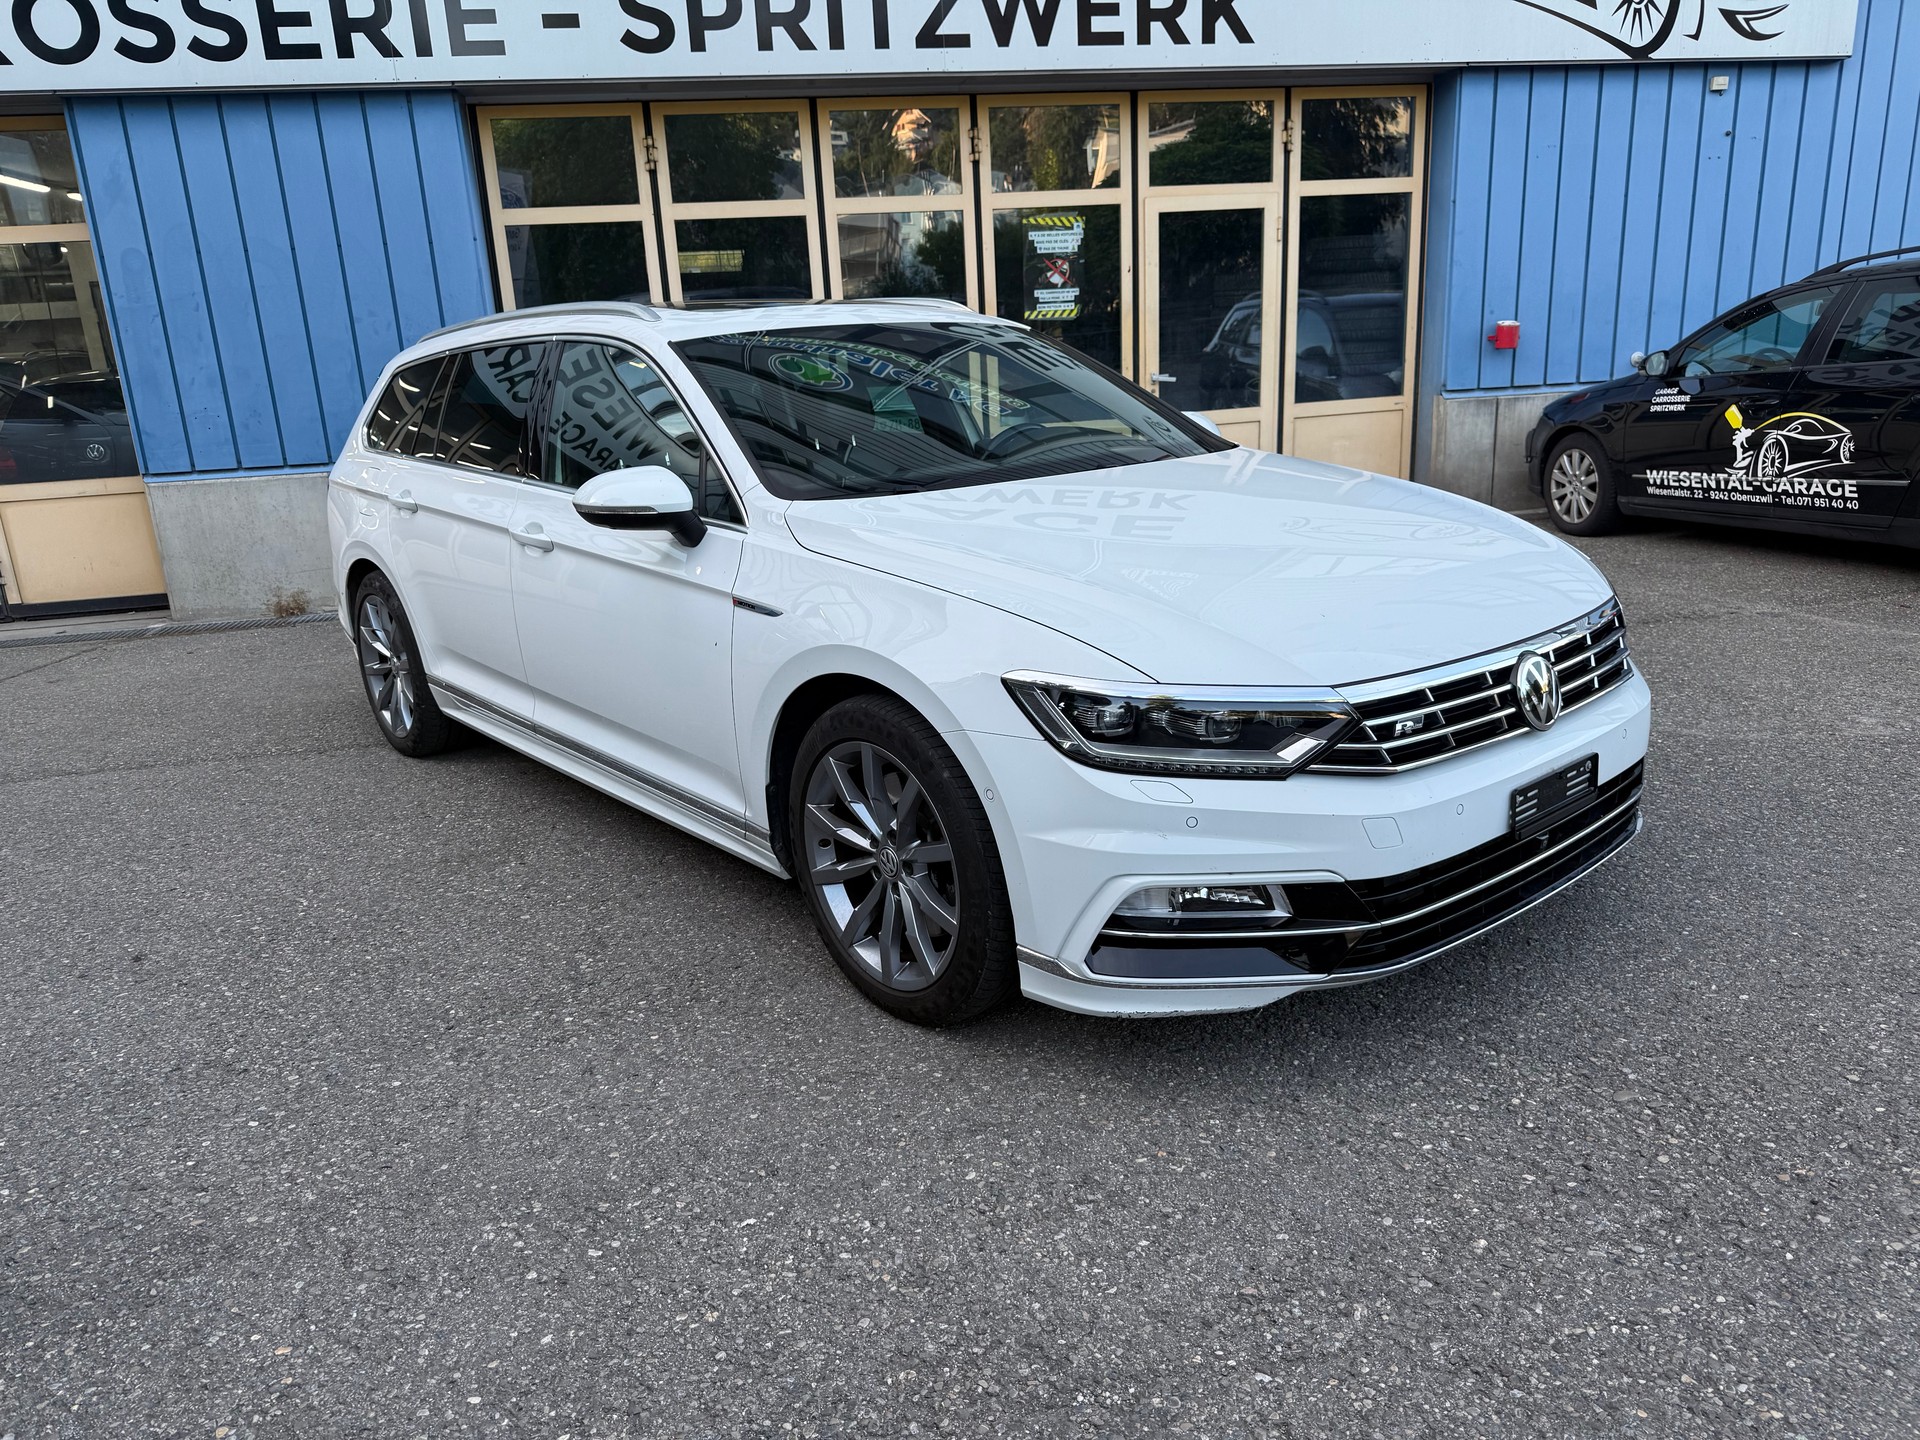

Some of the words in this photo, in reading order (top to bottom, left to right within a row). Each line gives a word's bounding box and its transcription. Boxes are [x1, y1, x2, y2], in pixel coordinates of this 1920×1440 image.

[0, 0, 506, 65] OSSERIE
[1651, 395, 1691, 403] CARROSSERIE
[1655, 387, 1679, 395] GARAGE
[1649, 404, 1686, 412] SPRITZWERK
[1645, 469, 1859, 498] WIESENTAL-GARAGE
[1646, 486, 1693, 498] Wiesentalstr.
[1693, 489, 1703, 499] 22
[1709, 490, 1729, 501] 9242
[1730, 492, 1773, 504] Oberuzwil
[1814, 497, 1829, 508] 951
[1831, 498, 1843, 508] 40
[1846, 499, 1859, 510] 40
